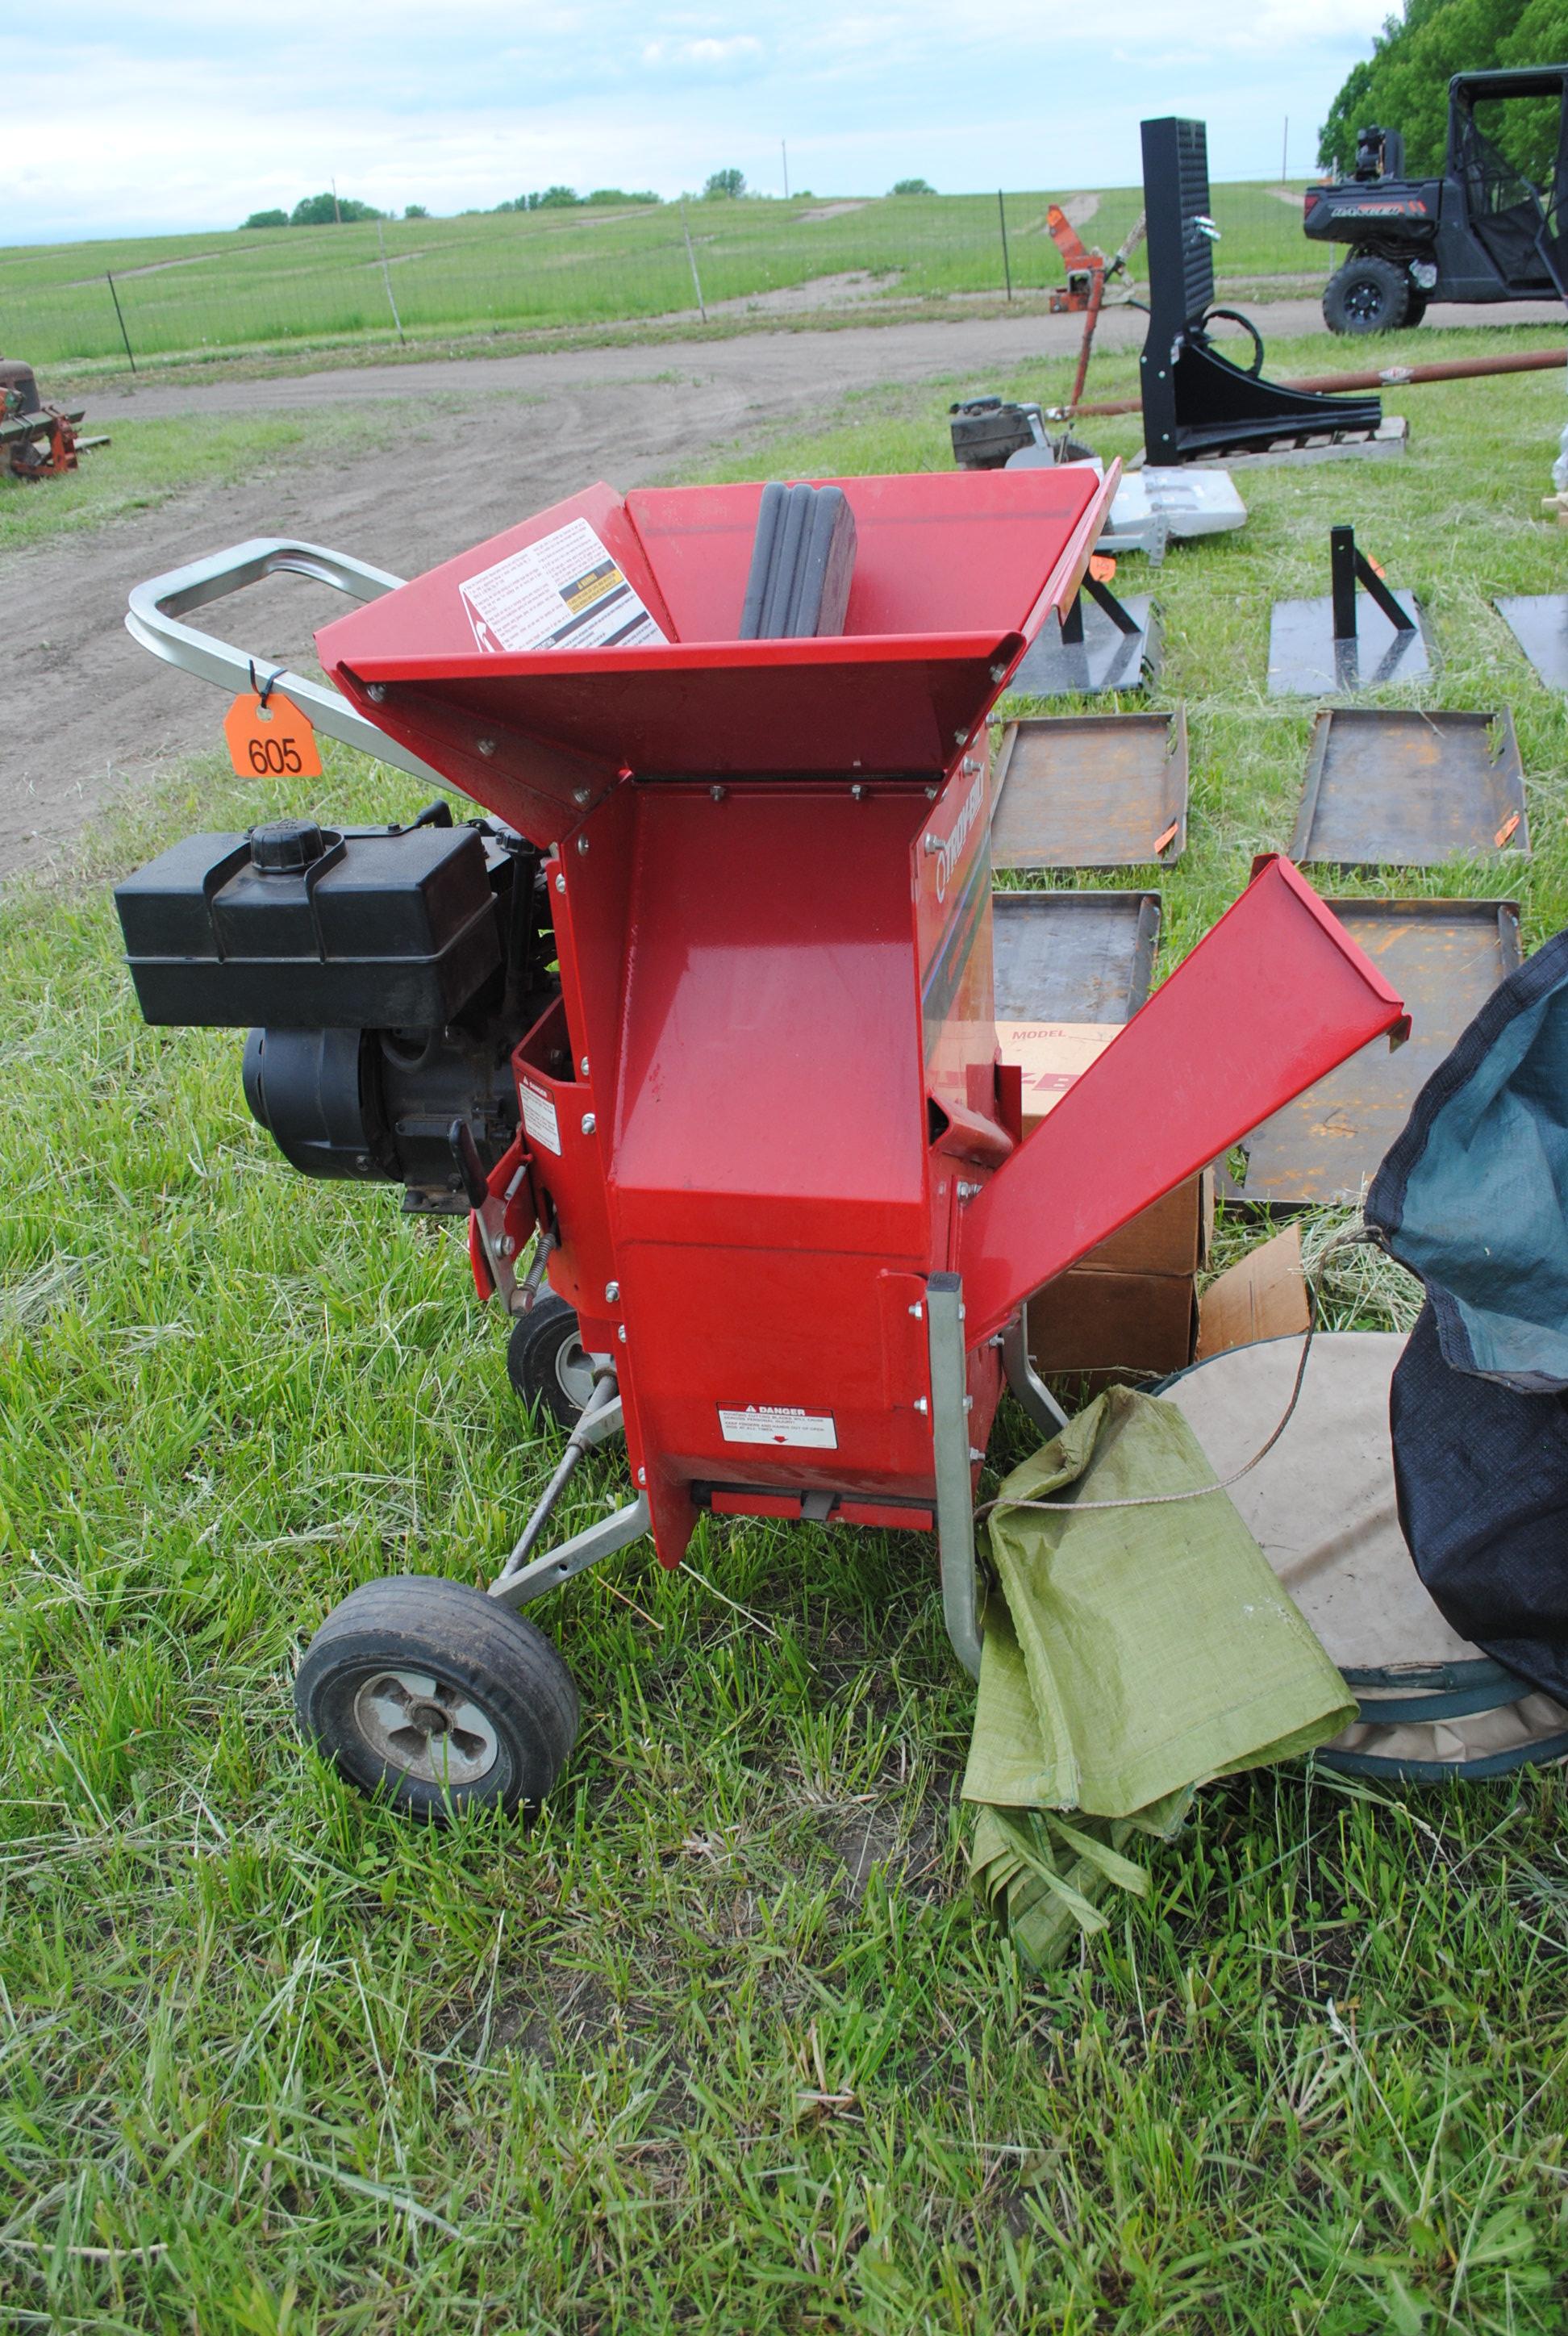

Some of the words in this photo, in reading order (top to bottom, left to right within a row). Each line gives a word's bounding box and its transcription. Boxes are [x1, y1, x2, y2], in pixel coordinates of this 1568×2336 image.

[248, 738, 302, 774] 605
[1011, 1030, 1067, 1041] MODEL
[759, 1406, 806, 1416] DANGER
